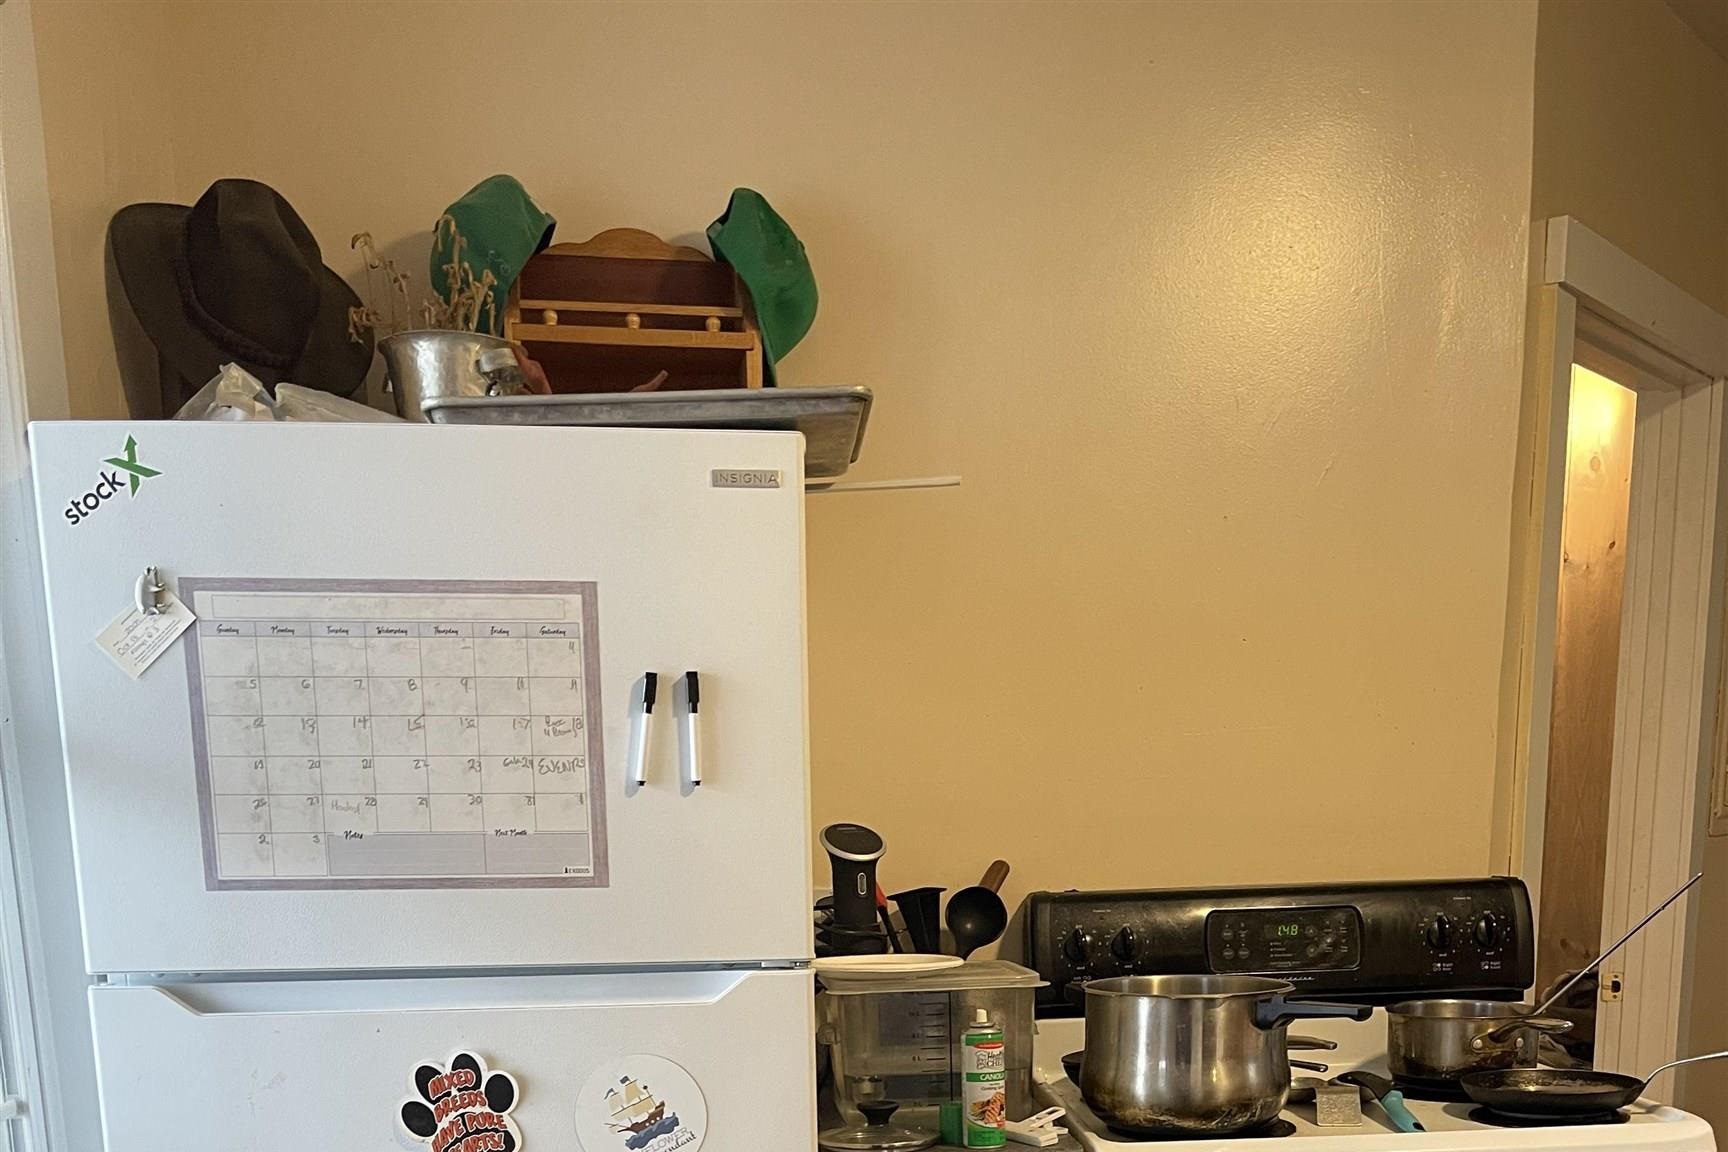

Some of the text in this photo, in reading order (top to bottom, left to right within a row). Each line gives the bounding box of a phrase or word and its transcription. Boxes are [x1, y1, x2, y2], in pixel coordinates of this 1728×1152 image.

[715, 472, 778, 484] INSIGNIA
[434, 626, 459, 636] Thursday
[490, 626, 510, 636] Friday
[539, 626, 566, 636] Saturday
[301, 679, 311, 689] 6
[408, 678, 418, 691] 8
[307, 759, 321, 770] 20
[362, 758, 373, 769] 21
[467, 758, 482, 773] 23
[428, 1069, 476, 1100] MIXED
[434, 1090, 488, 1123] BREEDS
[465, 1111, 508, 1132] PURE
